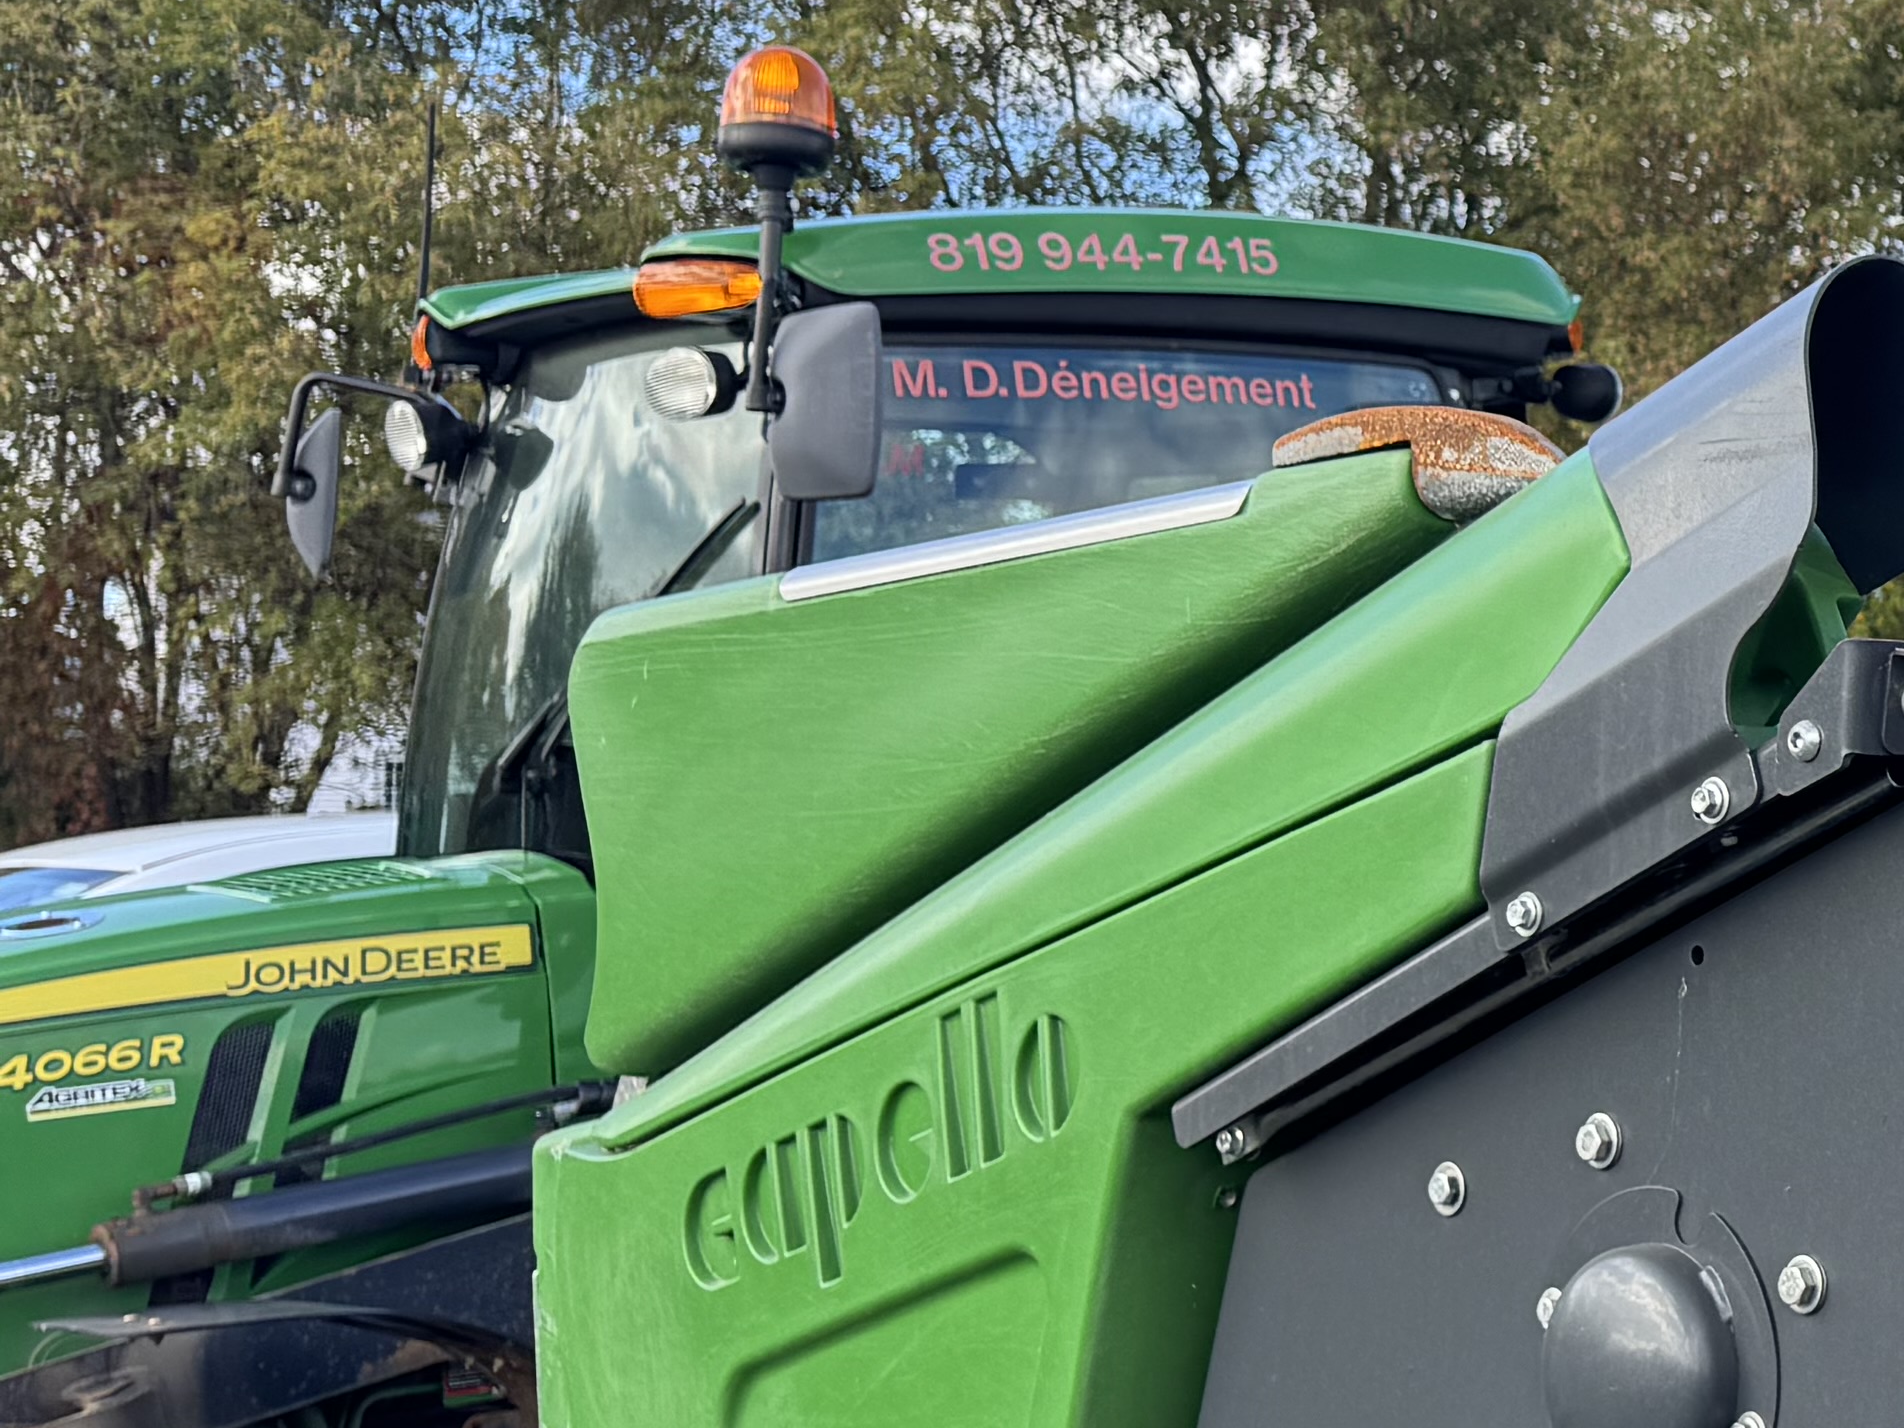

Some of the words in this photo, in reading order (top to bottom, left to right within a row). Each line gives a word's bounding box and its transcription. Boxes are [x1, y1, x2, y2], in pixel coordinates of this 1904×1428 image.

[927, 232, 1024, 272] 819
[1037, 231, 1280, 276] 944-7415
[891, 360, 948, 398] M.
[226, 954, 350, 991] JOHN
[360, 941, 502, 977] DEERE
